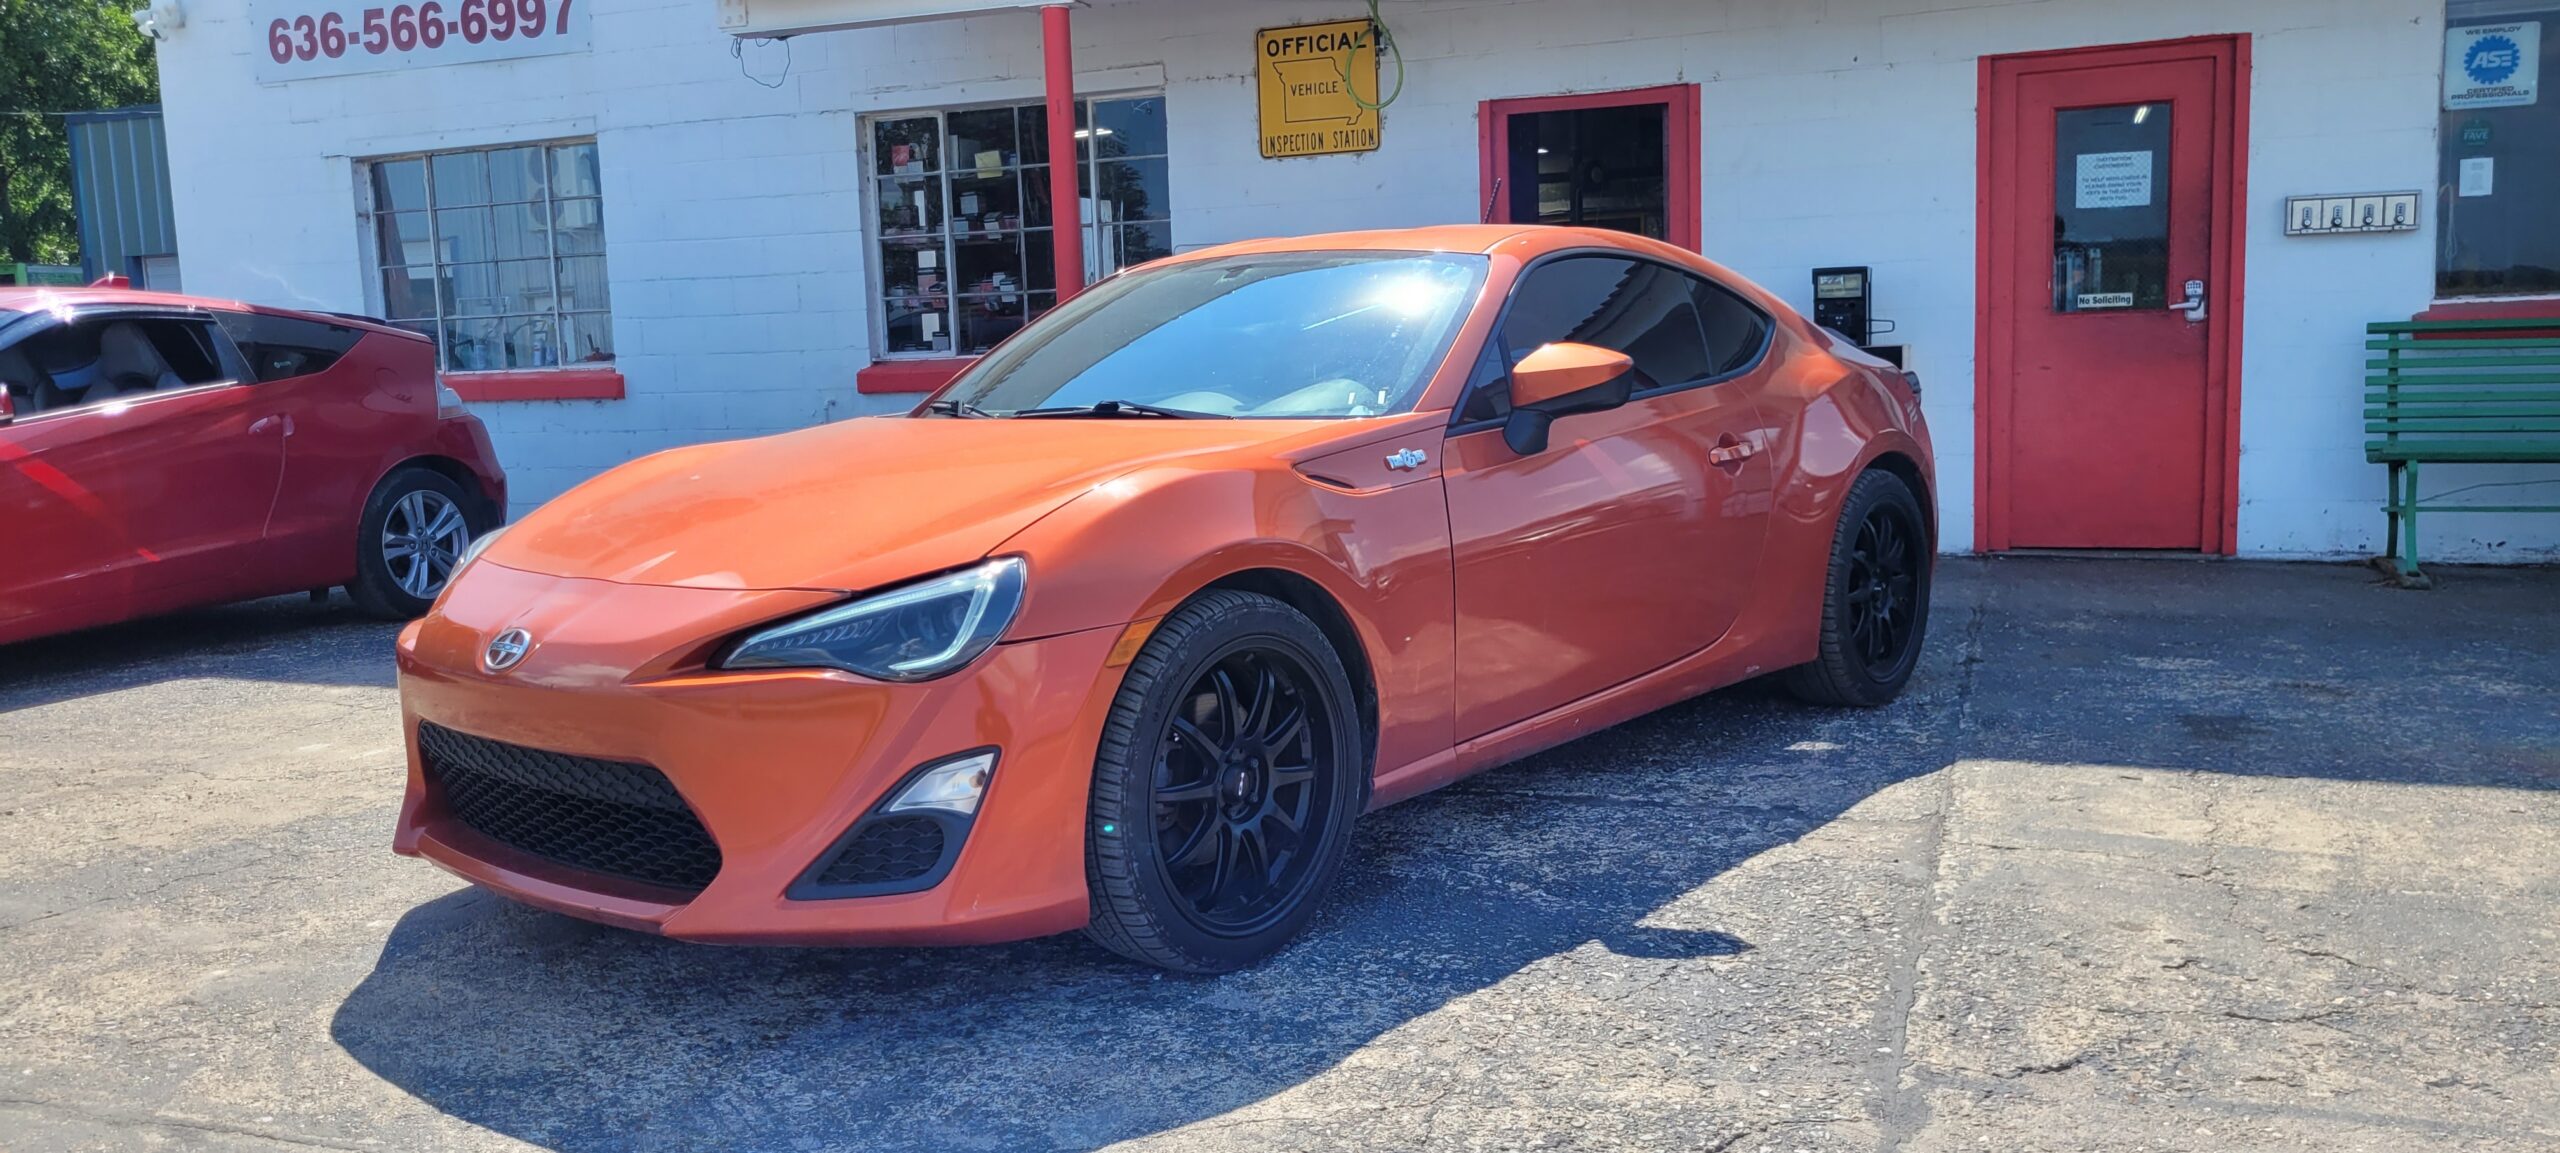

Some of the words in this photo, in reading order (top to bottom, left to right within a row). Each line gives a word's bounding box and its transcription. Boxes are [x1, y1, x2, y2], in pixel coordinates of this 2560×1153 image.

[268, 0, 573, 64] 636-566-6997
[2482, 26, 2521, 34] EMPLOY
[1266, 31, 1367, 57] OFFICIAL
[2470, 50, 2513, 69] ASE
[1290, 81, 1338, 96] VEHICLE
[2451, 90, 2530, 100] PROFESSIONALS
[1265, 132, 1324, 153] INSPECTION
[1333, 128, 1375, 149] STATION
[2092, 295, 2131, 305] Soliciting
